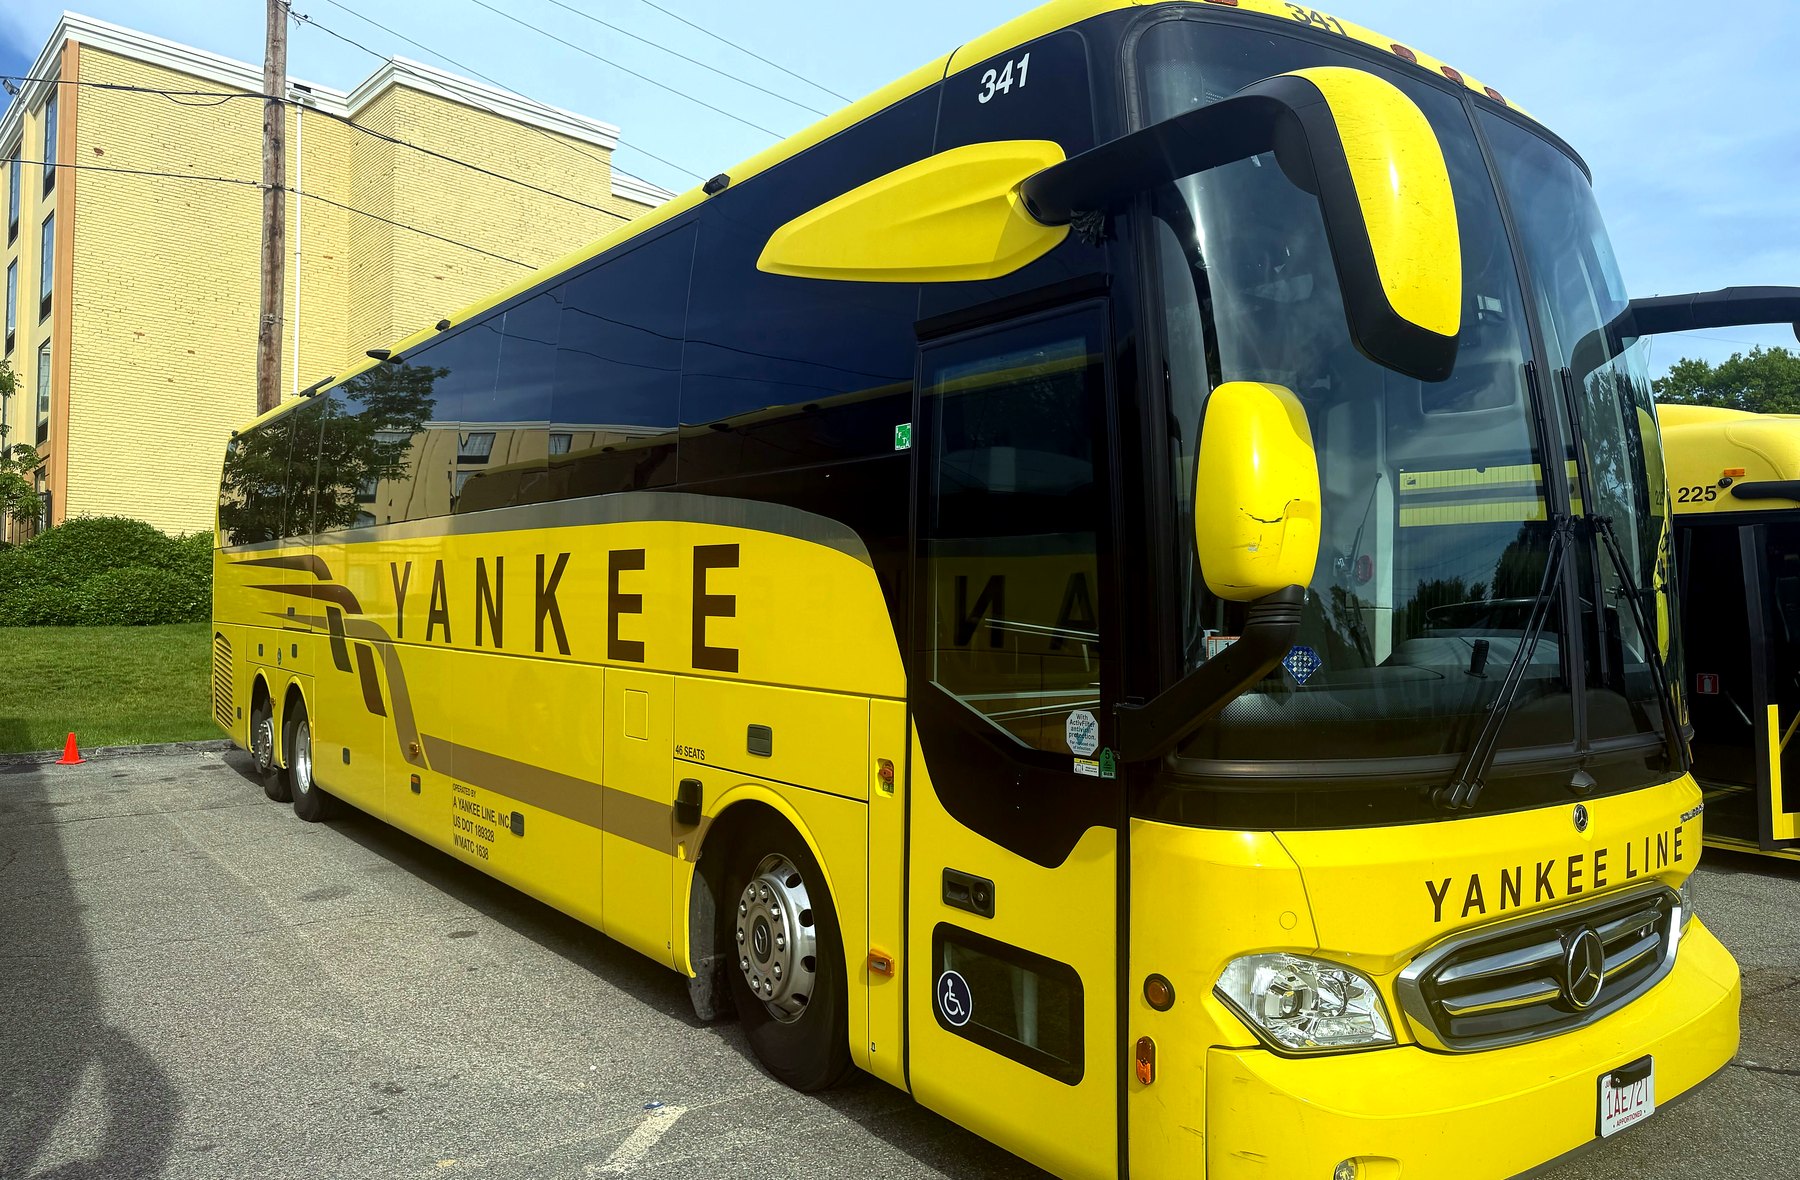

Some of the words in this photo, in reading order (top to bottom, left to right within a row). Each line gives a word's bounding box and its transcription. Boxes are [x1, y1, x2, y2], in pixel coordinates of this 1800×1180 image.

[1284, 2, 1348, 37] 341
[978, 52, 1030, 104] 341
[1677, 485, 1717, 503] 225
[390, 543, 740, 674] YANKEE
[675, 744, 683, 755] 46
[684, 745, 705, 761] SEATS
[1104, 749, 1111, 760] 5
[453, 783, 471, 796] OPERATED
[471, 789, 477, 798] BY
[453, 796, 457, 808] A
[458, 797, 481, 817] YANKEE
[481, 806, 497, 826] LINE,
[453, 814, 461, 829] US
[461, 818, 474, 834] DOT
[453, 832, 475, 854] WMATC
[476, 843, 489, 860] 1638
[1425, 848, 1607, 923] YANKEE
[1626, 826, 1683, 880] LINE
[1616, 1109, 1643, 1127] APPORTIONED
